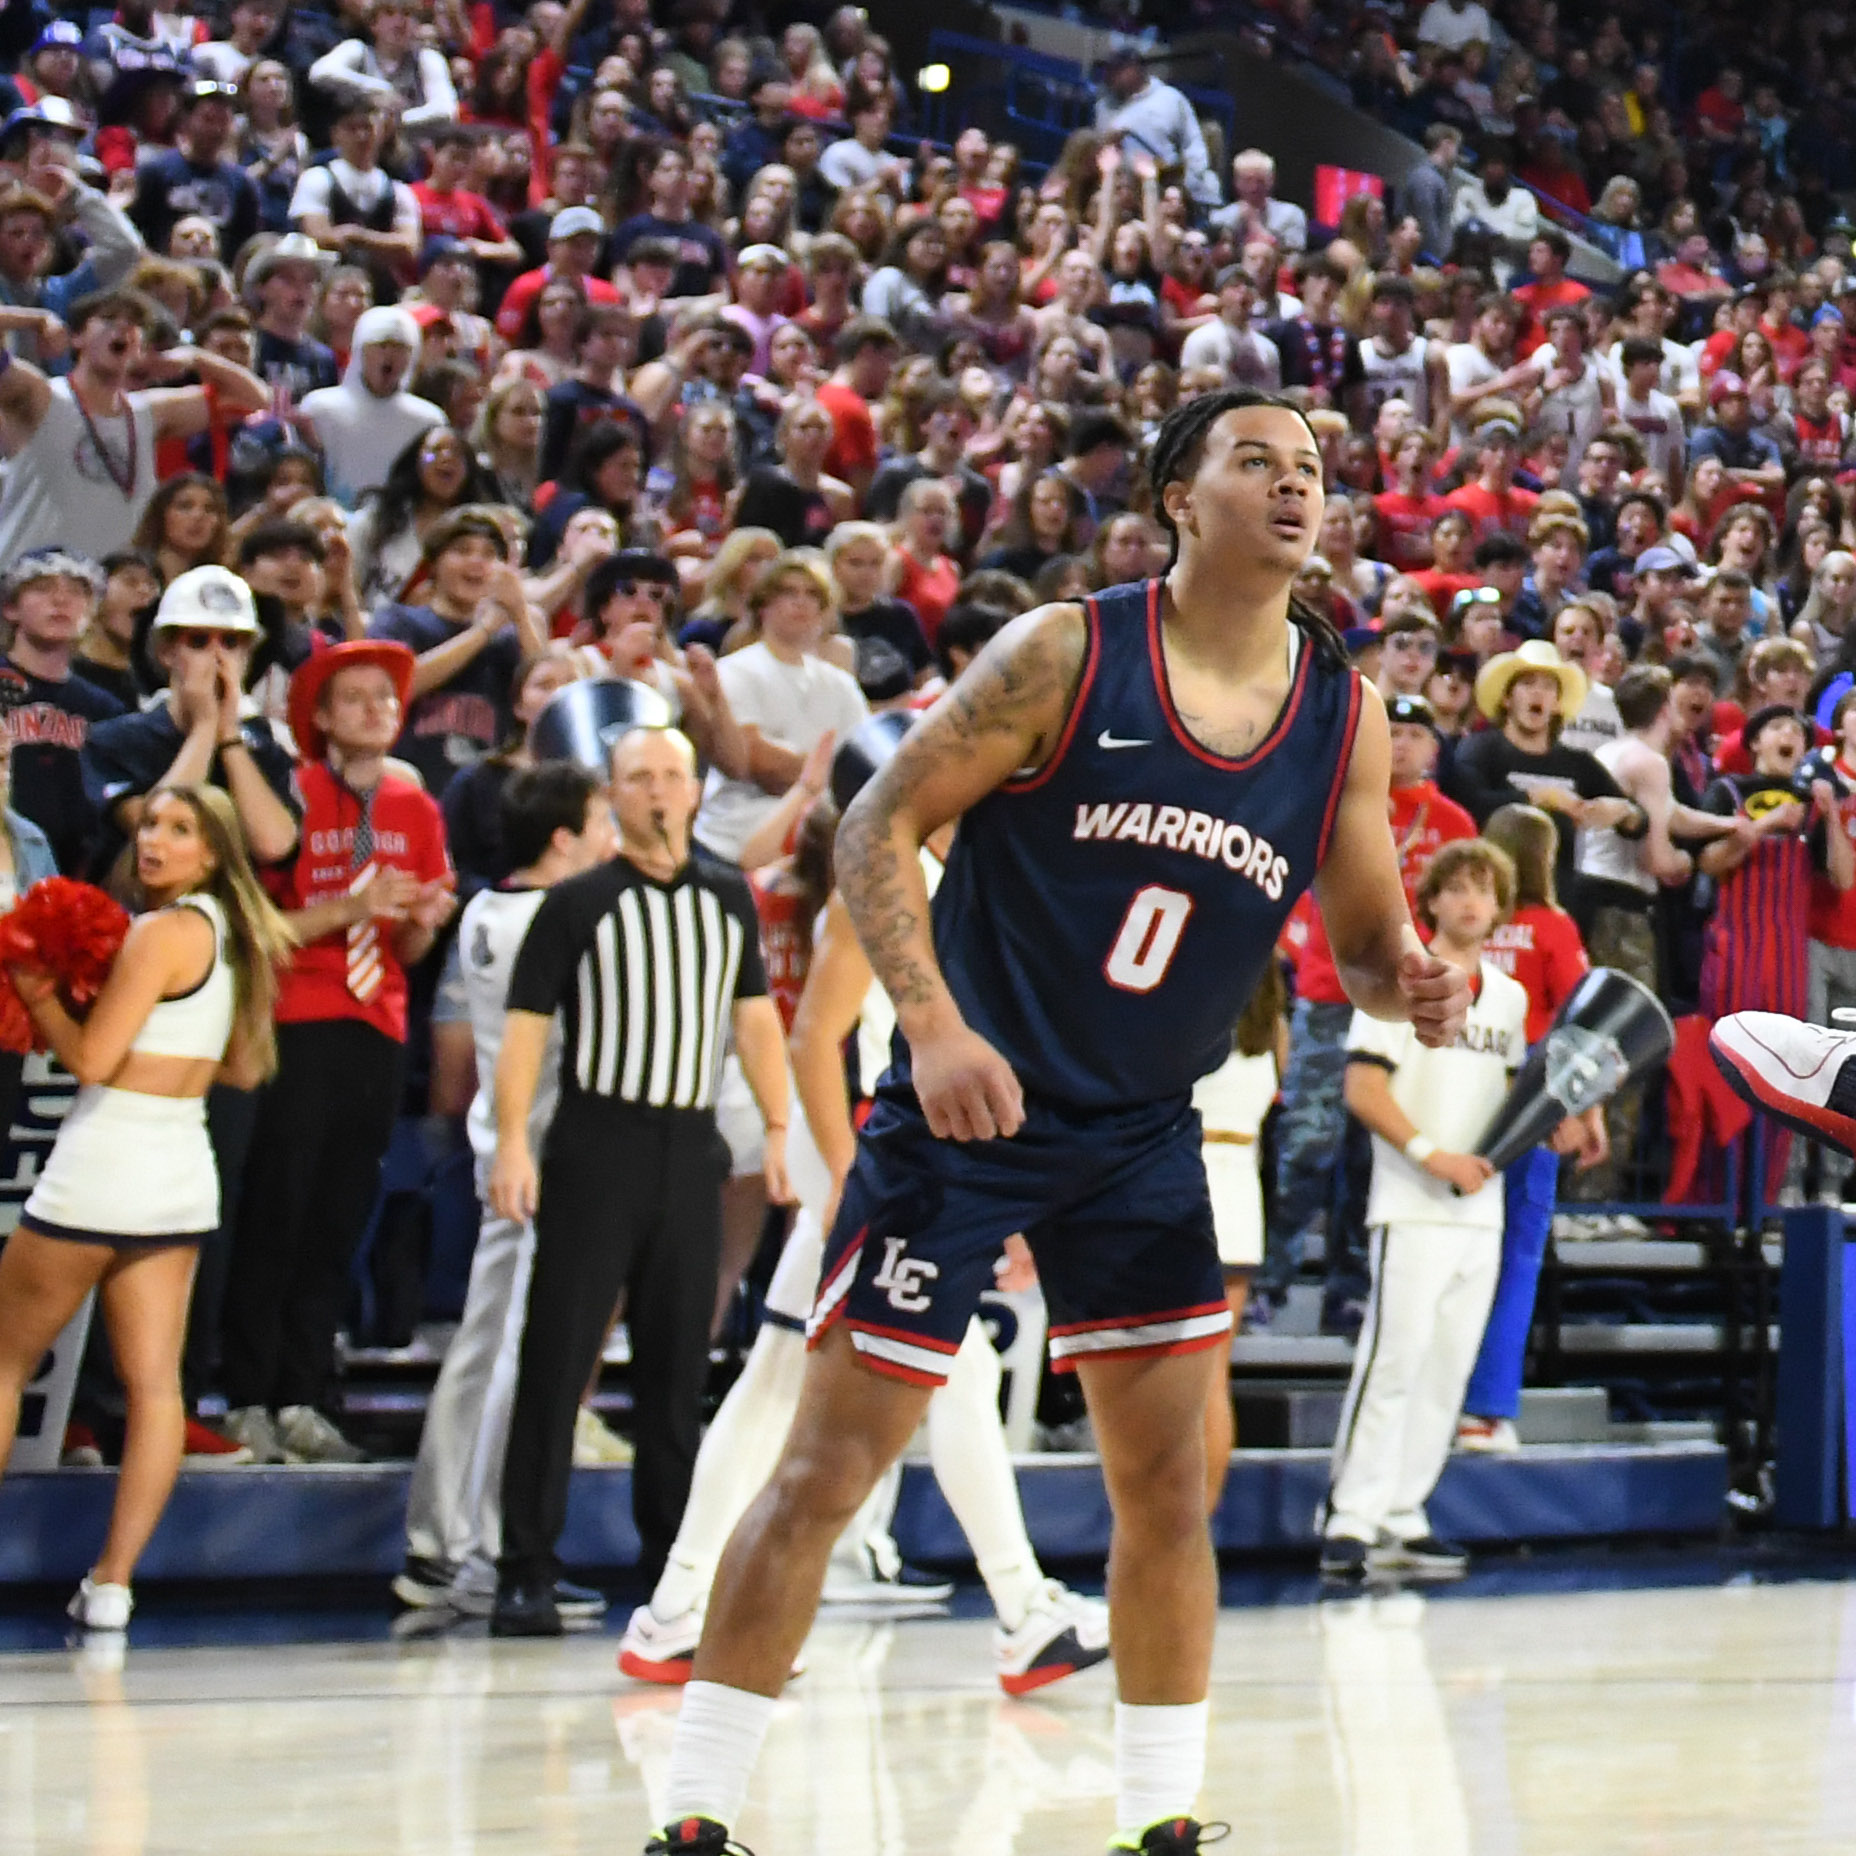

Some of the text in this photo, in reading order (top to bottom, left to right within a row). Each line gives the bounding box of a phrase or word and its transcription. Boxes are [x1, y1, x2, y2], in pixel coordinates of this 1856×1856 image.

[1072, 802, 1290, 903] WARRIORS
[1103, 881, 1196, 996] 0
[872, 1236, 940, 1313] LC
